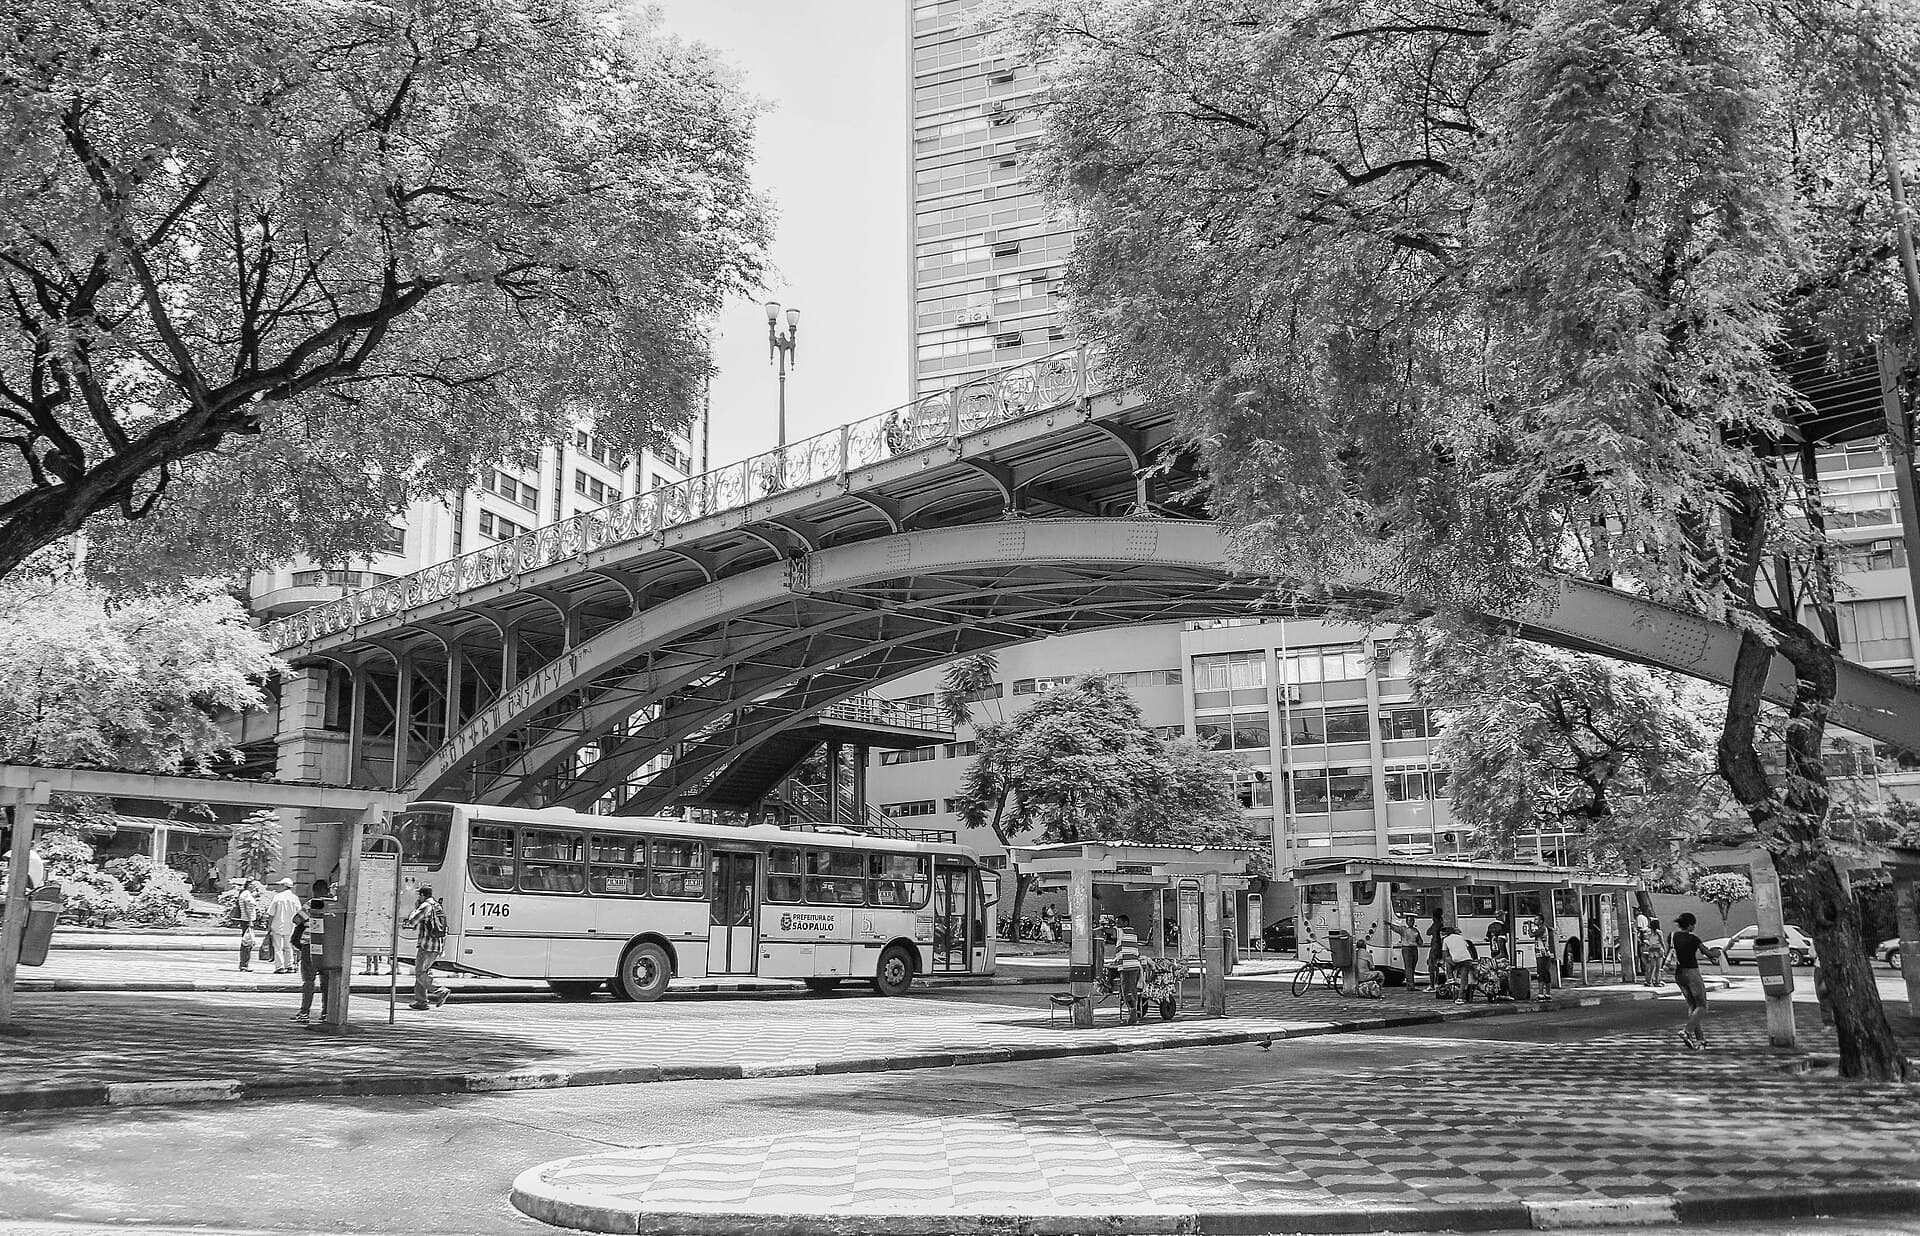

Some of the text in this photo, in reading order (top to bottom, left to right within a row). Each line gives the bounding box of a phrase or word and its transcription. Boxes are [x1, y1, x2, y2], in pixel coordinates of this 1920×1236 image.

[469, 902, 510, 917] 1 1746
[792, 913, 826, 921] PREFEITURA
[809, 922, 834, 931] PAULO
